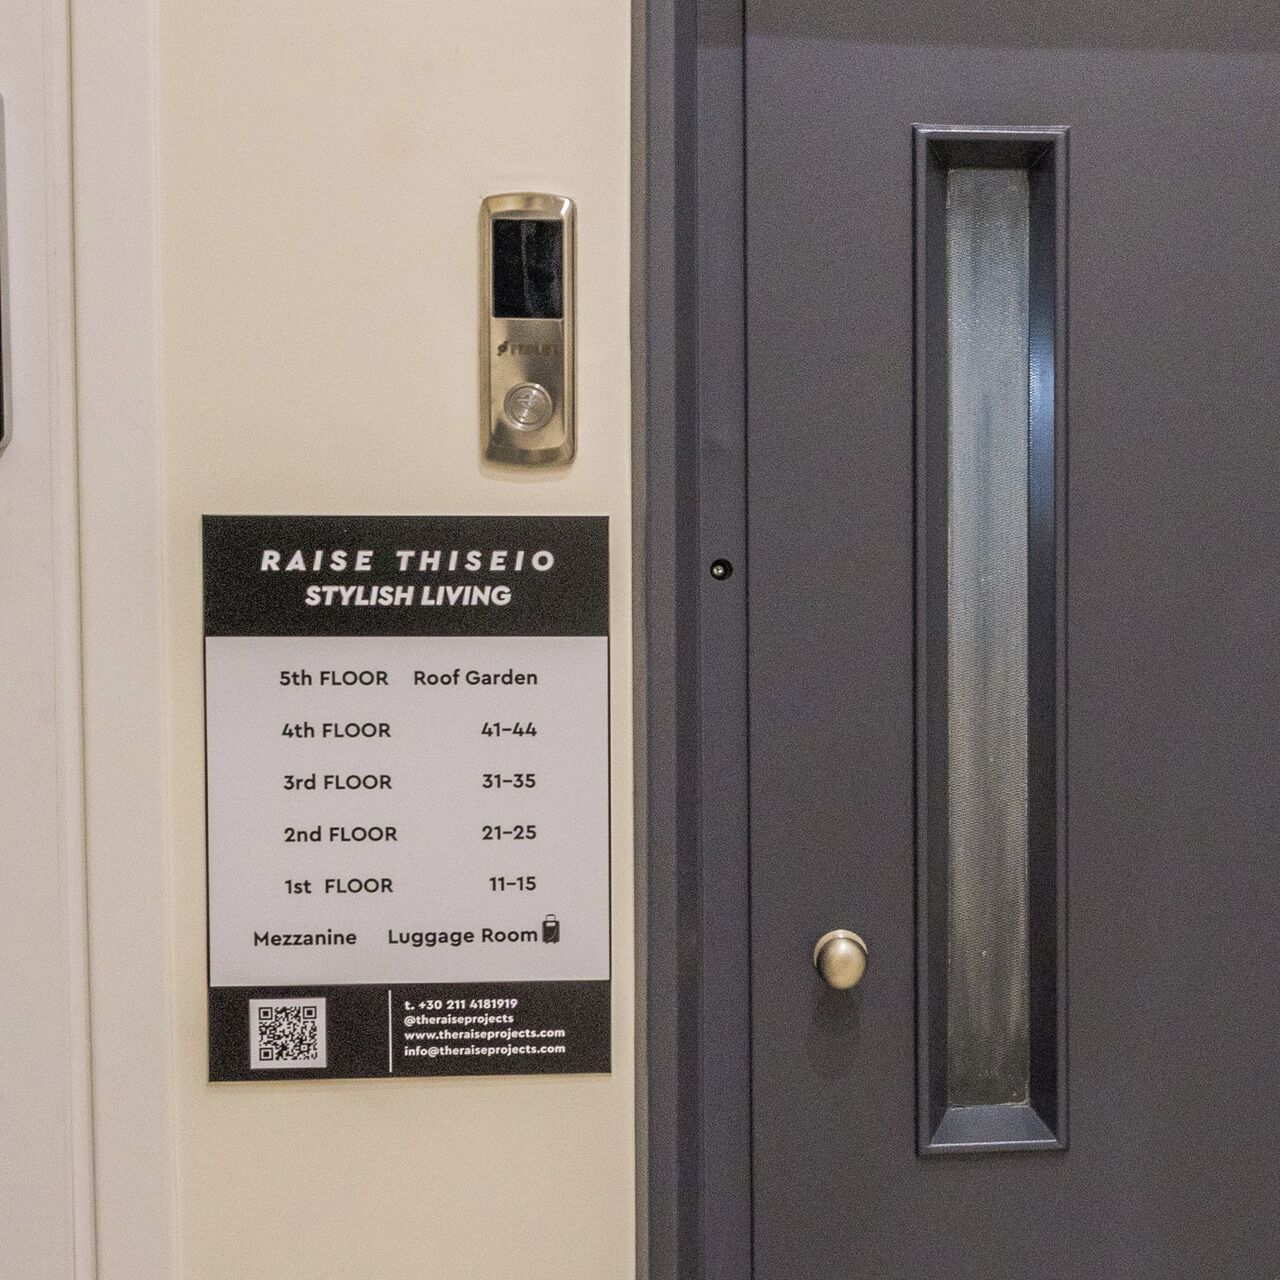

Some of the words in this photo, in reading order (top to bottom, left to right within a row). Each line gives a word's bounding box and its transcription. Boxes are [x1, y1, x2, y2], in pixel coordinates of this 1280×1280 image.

[260, 549, 374, 572] RAISE
[395, 550, 555, 572] THISEIO
[304, 585, 415, 606] STYLISH
[420, 585, 512, 606] LIVING
[279, 669, 313, 686] 5th
[320, 670, 389, 686] FLOOR
[414, 668, 461, 686] Roof
[465, 668, 538, 686] Garden
[281, 721, 315, 739] 4th
[322, 722, 391, 738] FLOOR
[283, 773, 316, 791] 3rd
[323, 774, 392, 790] FLOOR
[284, 825, 322, 843] 2nd
[329, 826, 398, 842] FLOOR
[284, 879, 312, 895] 1st
[325, 877, 394, 894] FLOOR
[253, 928, 357, 947] Mezzanine
[388, 929, 475, 948] Luggage
[481, 927, 538, 943] Room
[404, 1000, 415, 1011] t.
[418, 999, 443, 1011] +30
[446, 999, 466, 1010] 211
[469, 998, 518, 1010] 4181919
[403, 1013, 514, 1027] @theraiseprojects
[404, 1027, 566, 1041] www.theraiseprojects.com
[404, 1043, 566, 1058] info@theraiseprojects.com
